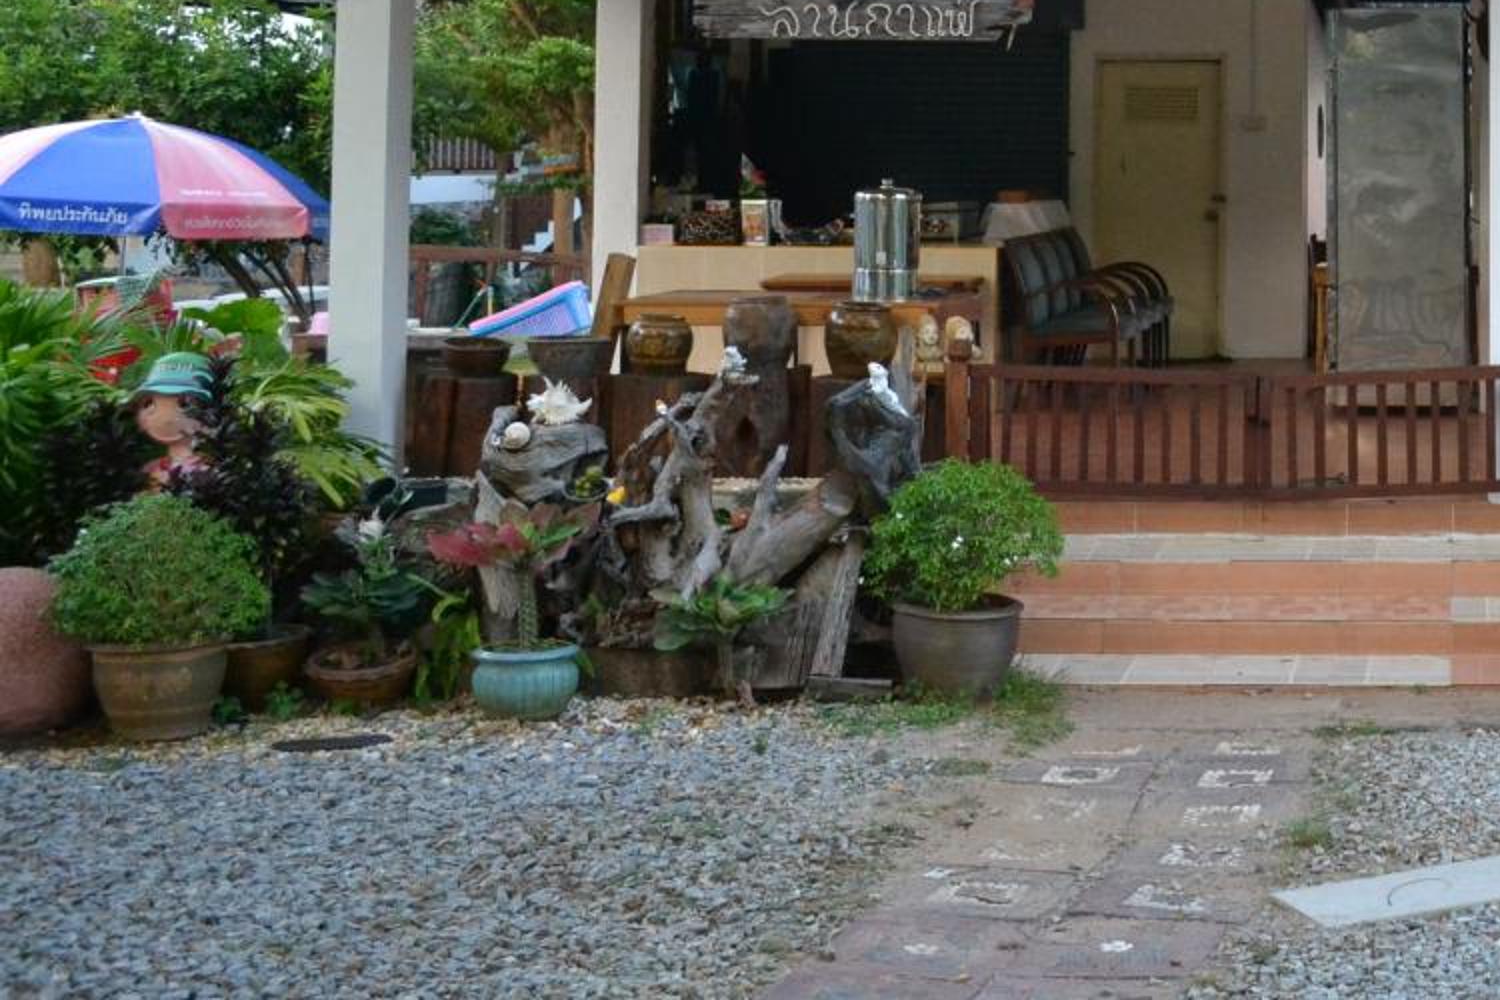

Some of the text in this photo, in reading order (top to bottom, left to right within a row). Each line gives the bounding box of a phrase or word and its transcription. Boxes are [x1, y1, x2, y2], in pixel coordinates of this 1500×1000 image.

[17, 201, 129, 225] ทิพยประกันภัย
